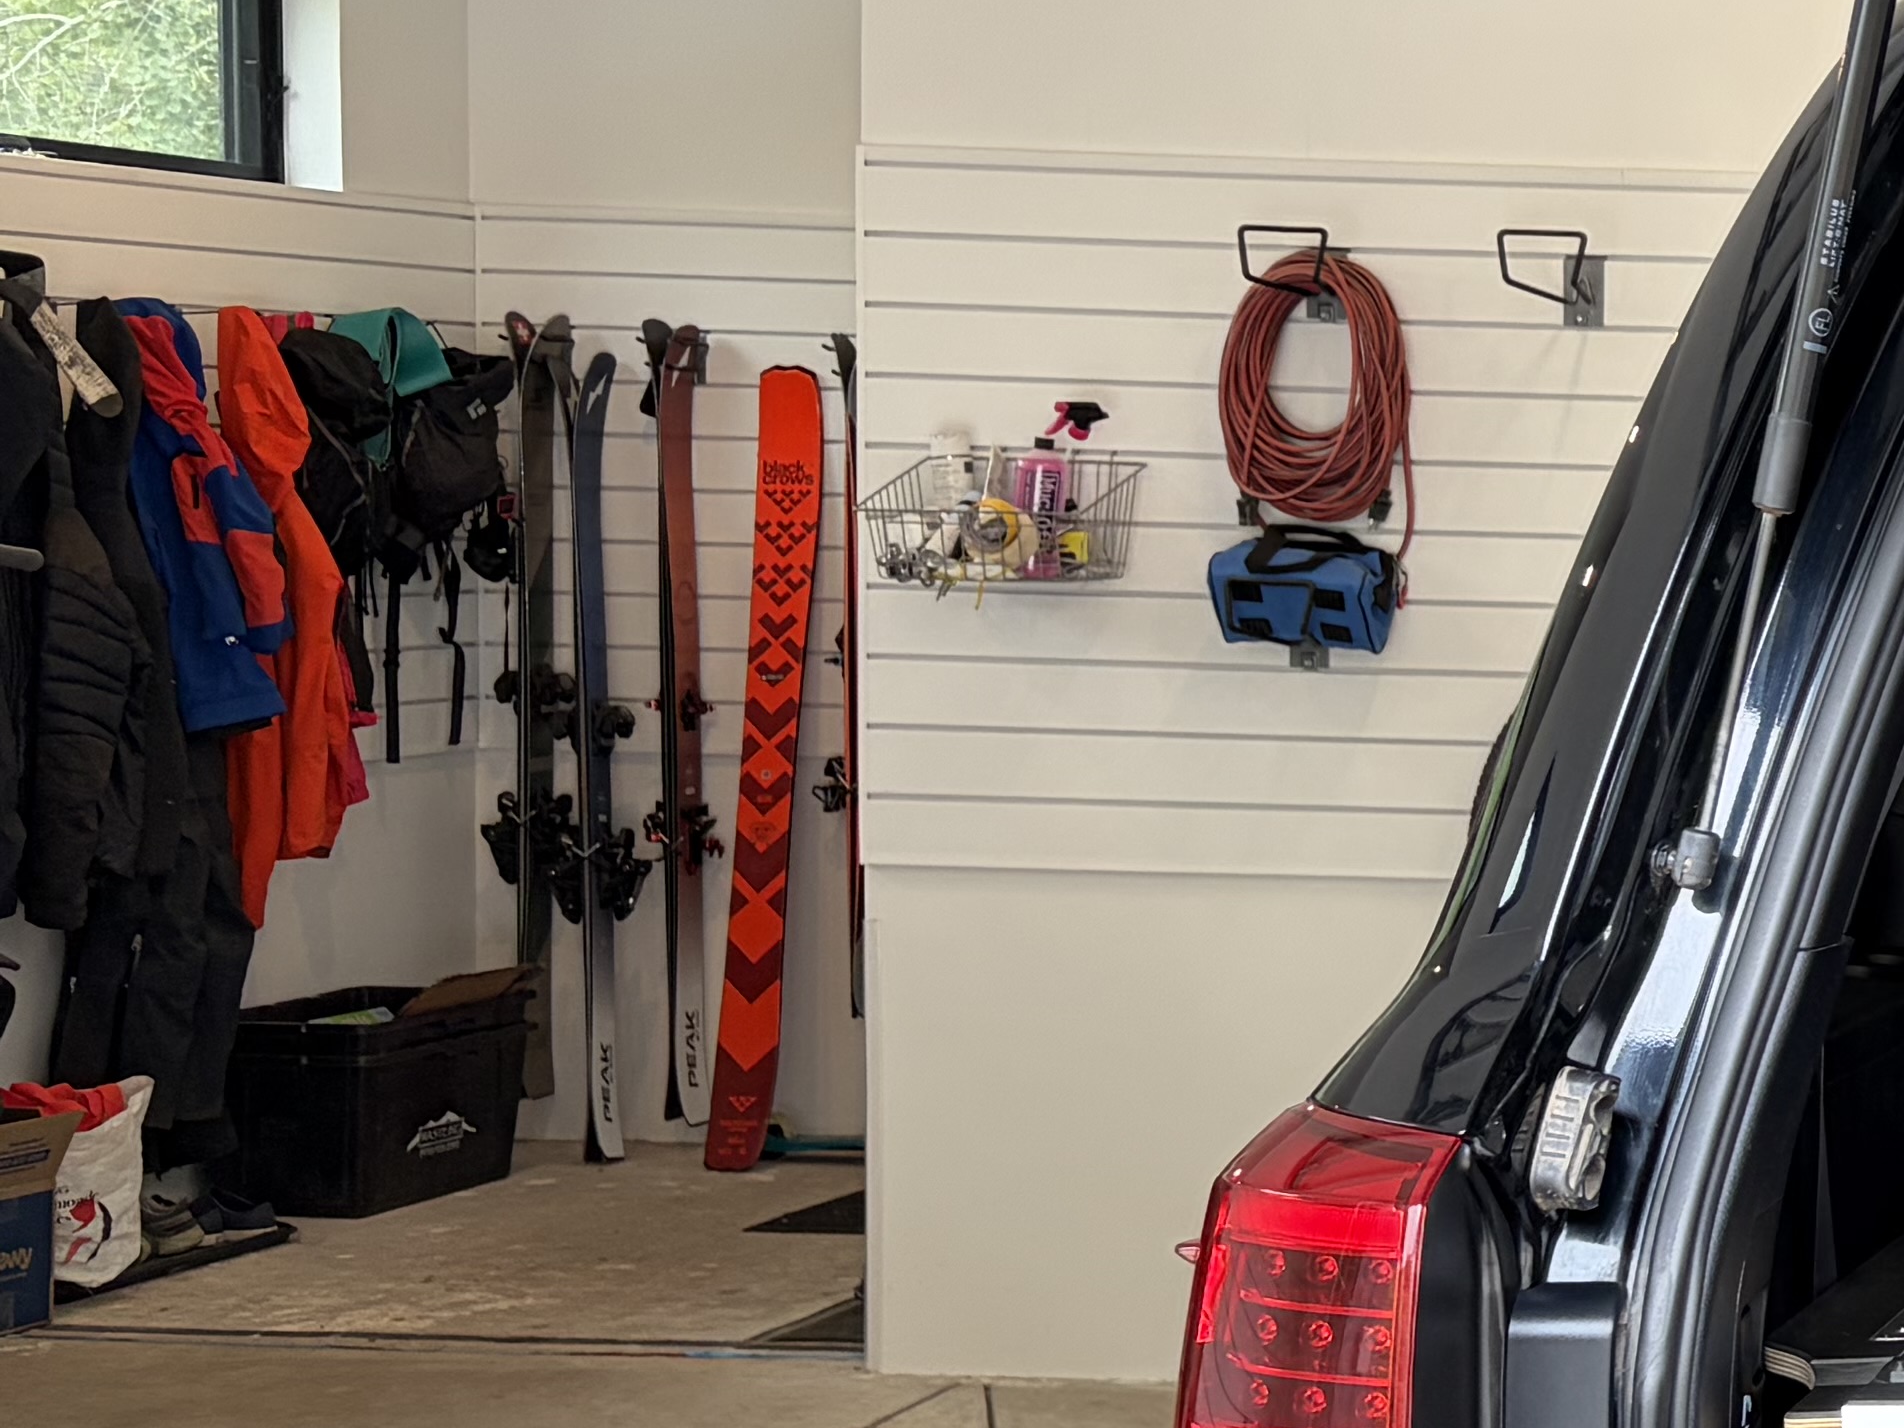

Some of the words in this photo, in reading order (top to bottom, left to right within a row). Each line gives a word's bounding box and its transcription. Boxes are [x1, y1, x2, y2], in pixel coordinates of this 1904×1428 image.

[762, 459, 805, 477] black
[600, 1040, 613, 1123] PEAK
[685, 1010, 699, 1088] PEAK
